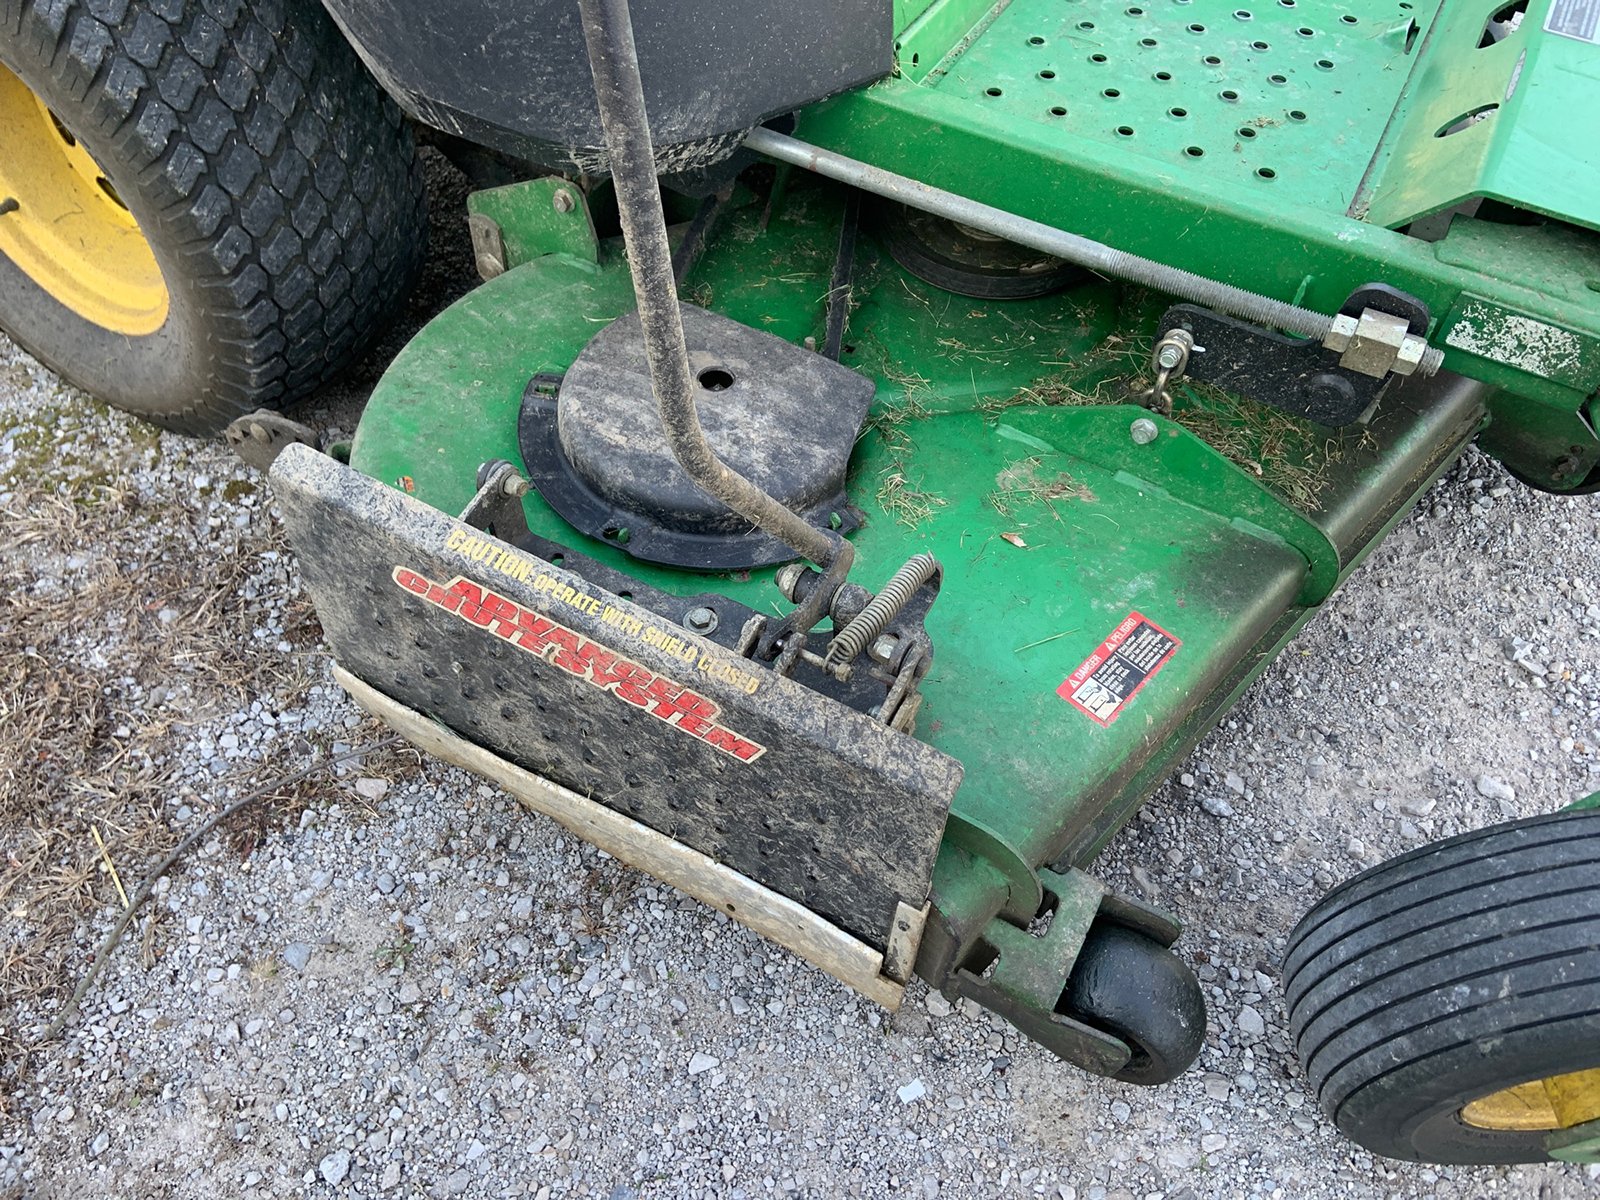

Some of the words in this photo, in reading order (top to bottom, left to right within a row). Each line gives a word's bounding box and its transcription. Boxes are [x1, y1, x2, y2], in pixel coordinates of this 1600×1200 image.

[534, 574, 602, 616] OPERATE
[601, 605, 643, 636] WITH
[642, 626, 698, 663] SHIELD
[1109, 617, 1137, 643] PELIGRO
[395, 569, 549, 656] CHUTE
[552, 648, 762, 761] SYSTEM
[450, 579, 720, 720] ADVANCED
[1073, 653, 1102, 680] DANGER
[1096, 663, 1108, 674] avoid
